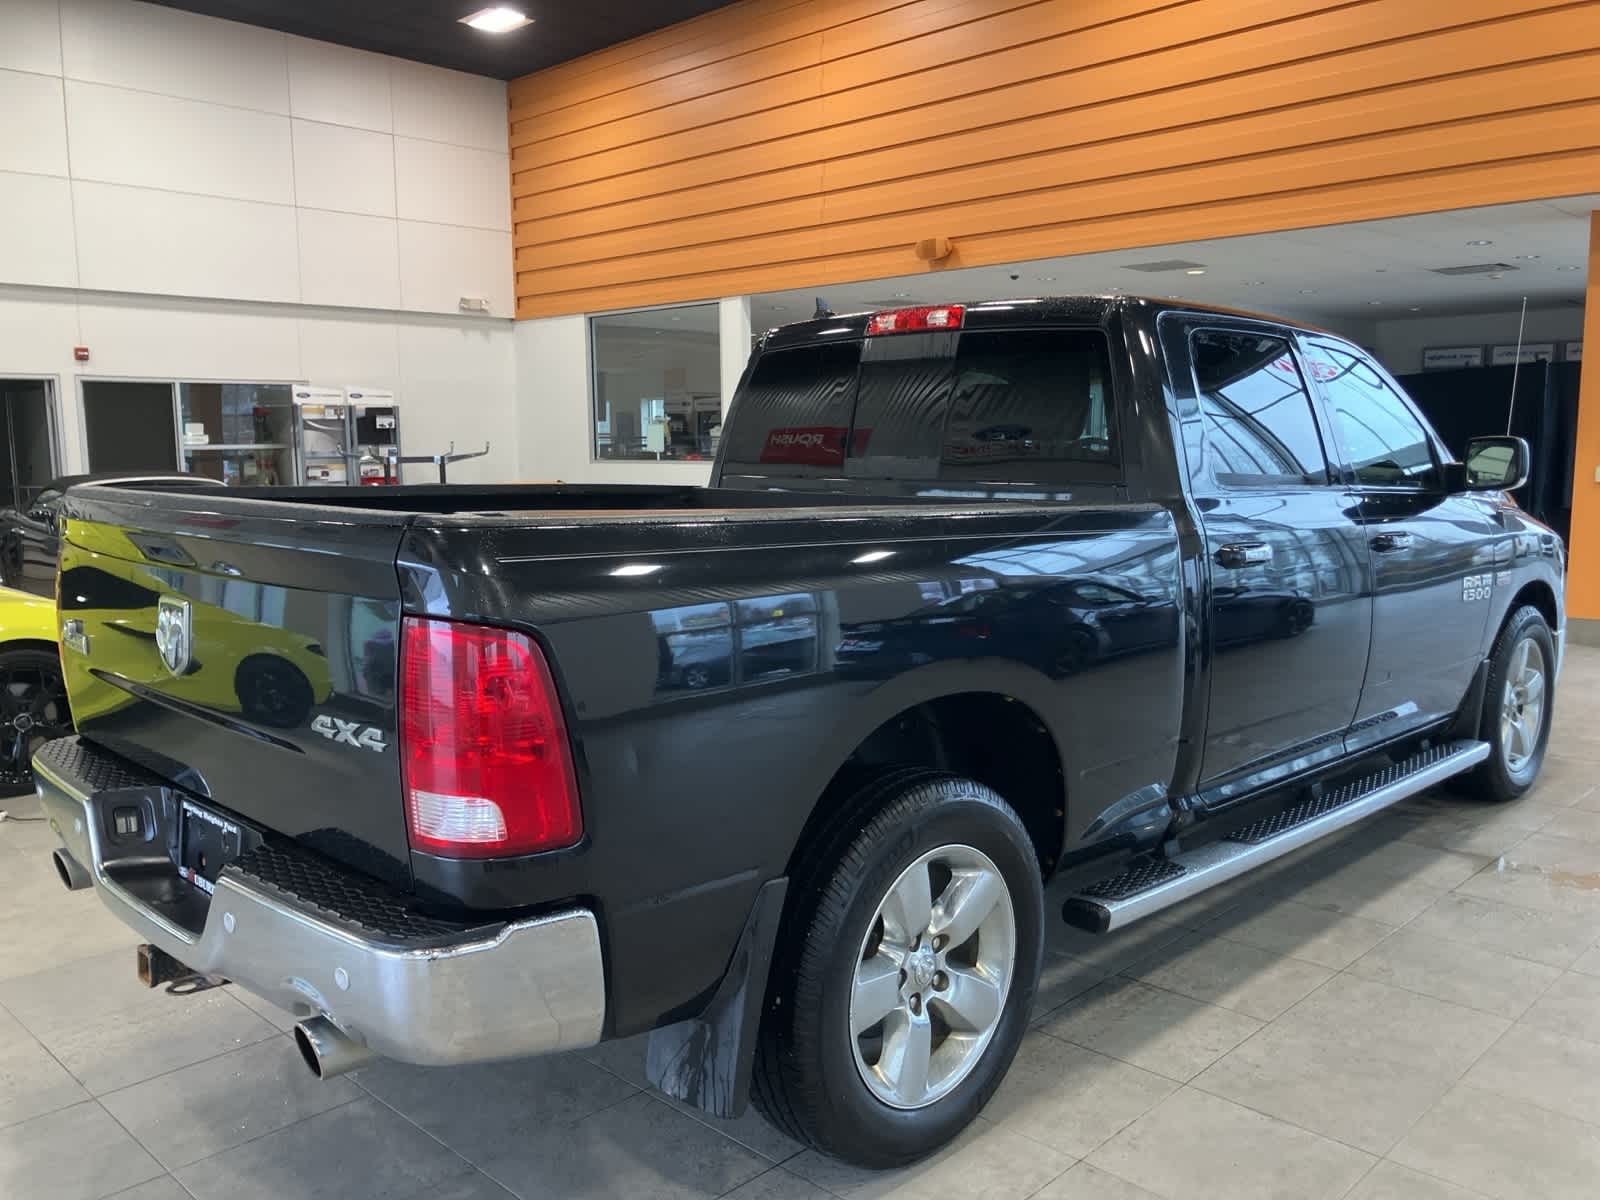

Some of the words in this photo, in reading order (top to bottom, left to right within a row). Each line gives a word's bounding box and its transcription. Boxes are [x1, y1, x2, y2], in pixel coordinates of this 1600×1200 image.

[1463, 574, 1492, 588] RAM
[1463, 587, 1491, 601] 1500
[311, 714, 388, 752] 4X4
